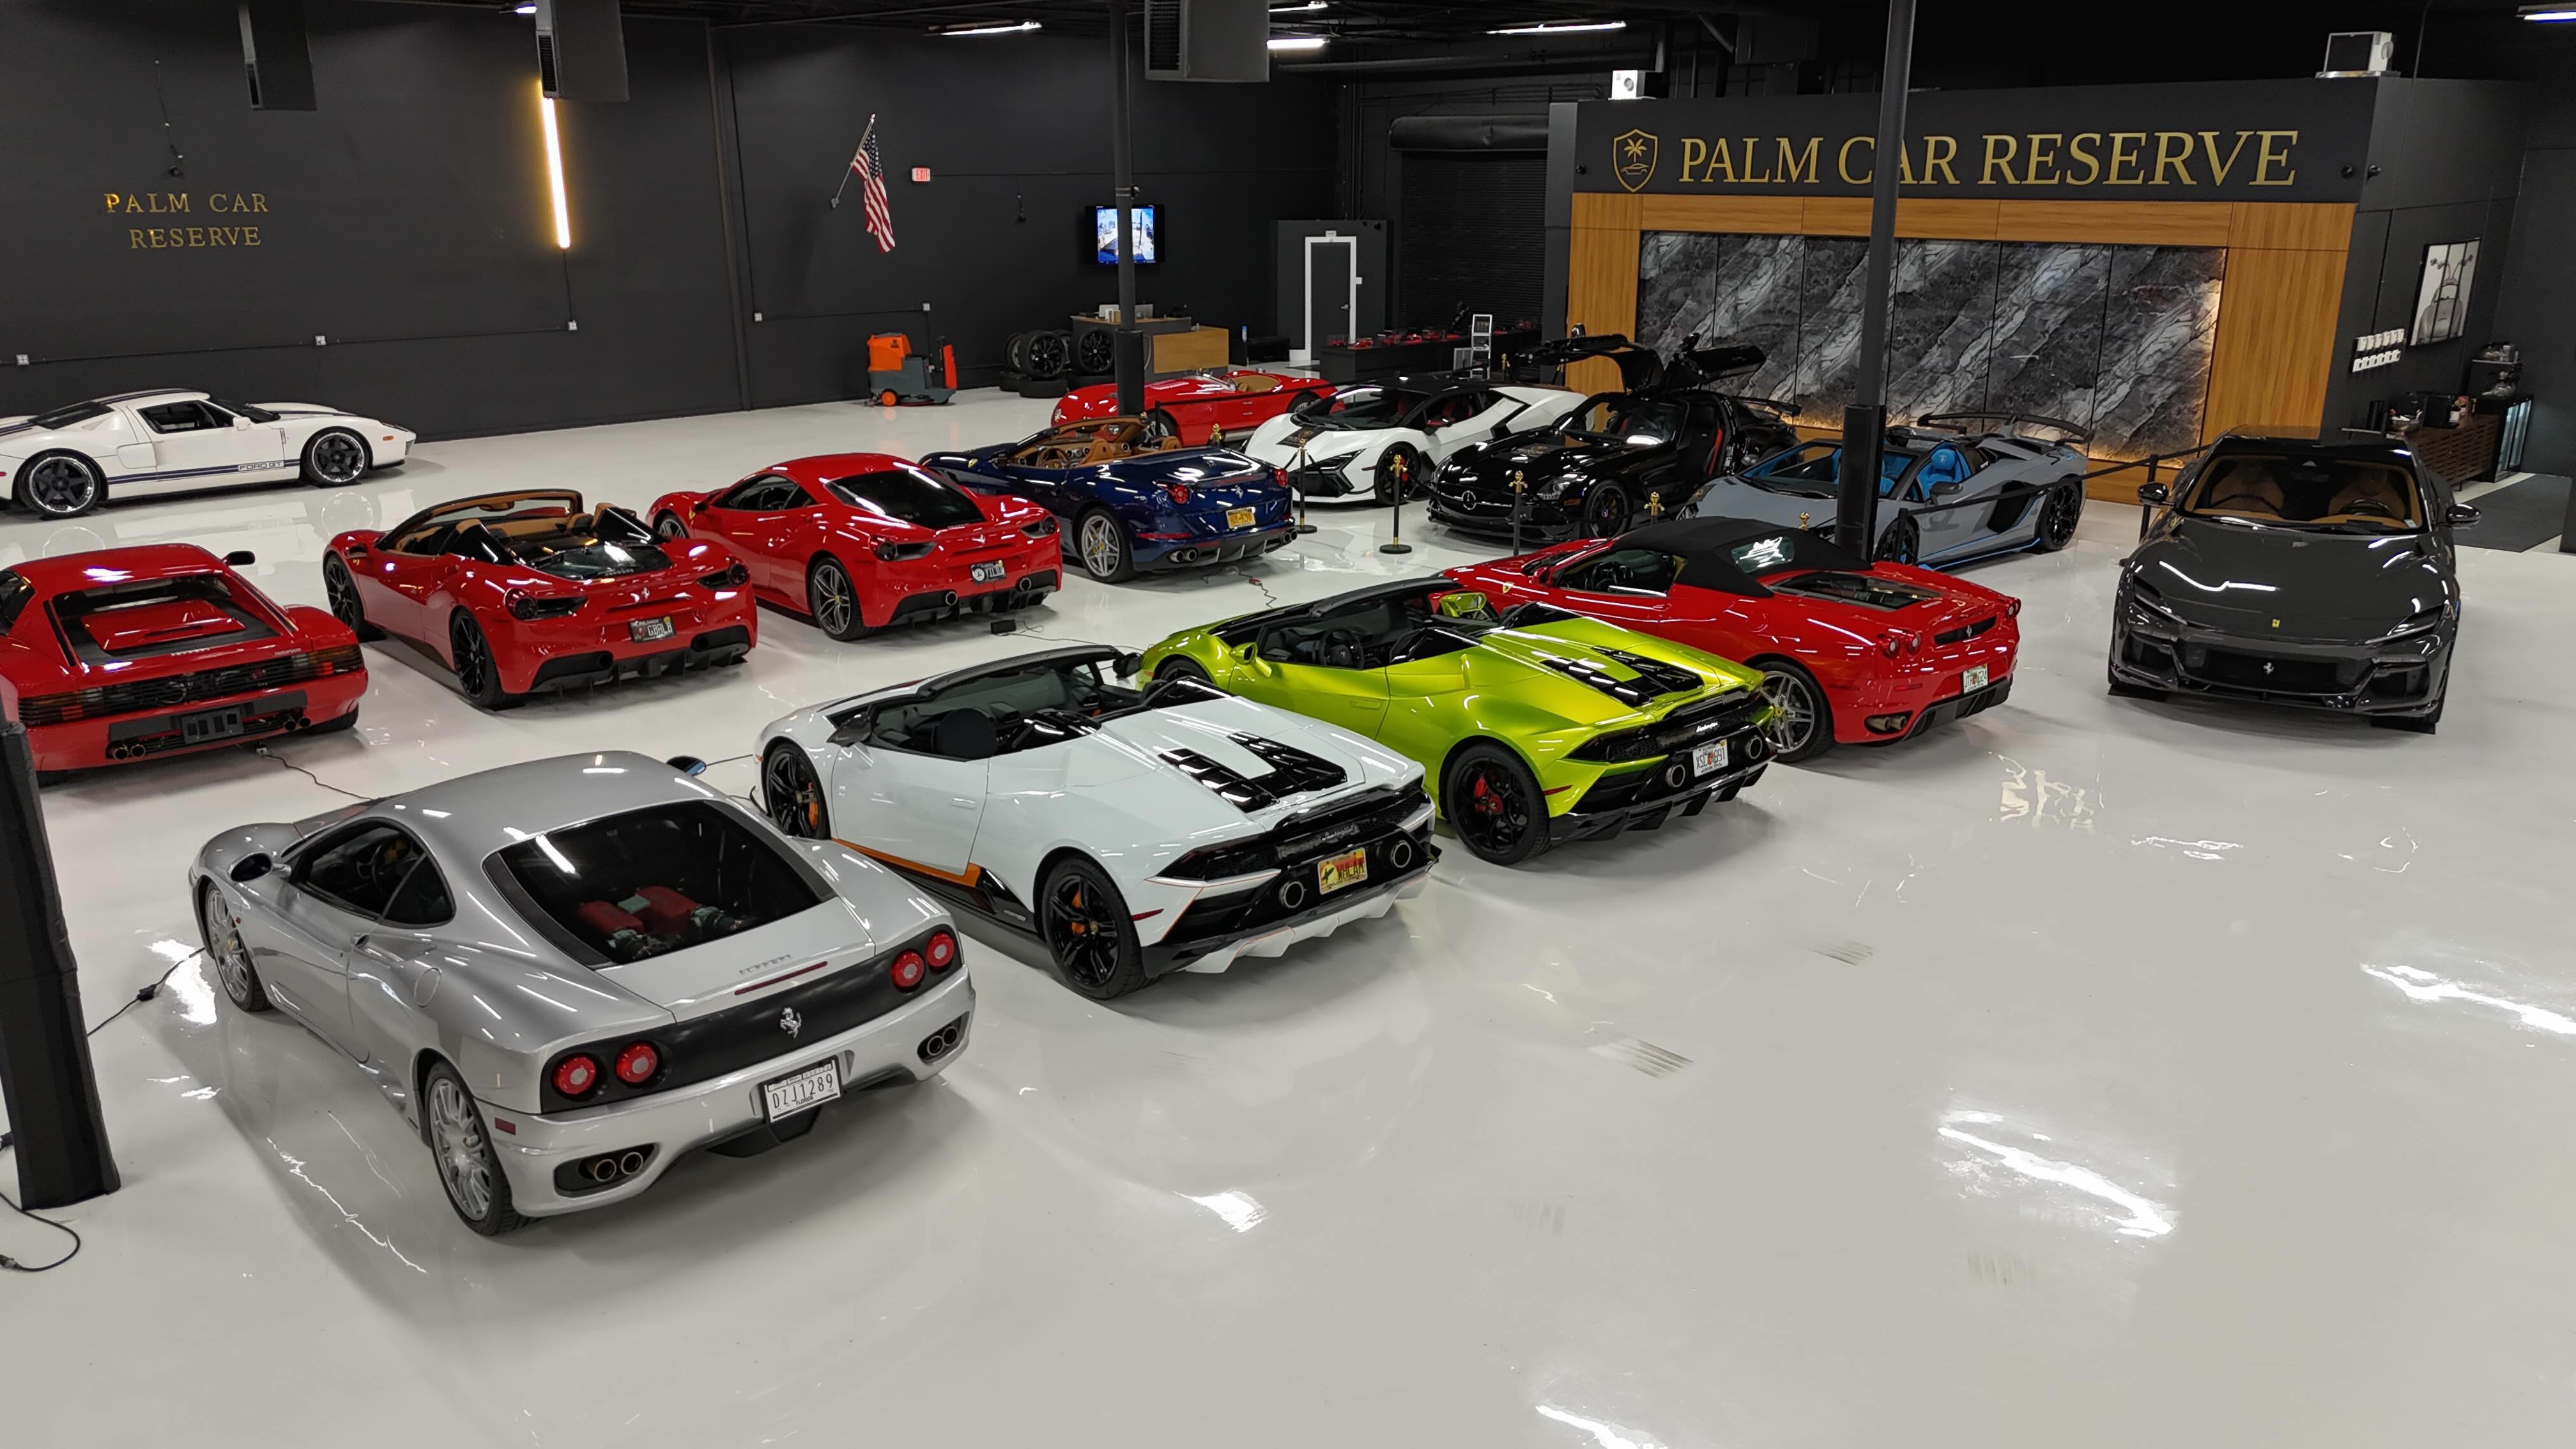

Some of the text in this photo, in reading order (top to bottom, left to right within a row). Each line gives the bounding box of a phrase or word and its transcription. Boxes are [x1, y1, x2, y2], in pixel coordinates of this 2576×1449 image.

[1678, 137, 1824, 184] PALM
[1977, 130, 2299, 187] RESERVE
[916, 168, 928, 180] EXIT
[103, 193, 269, 213] PALM CAR
[128, 226, 261, 249] RESERVE
[240, 462, 267, 470] FORD
[1695, 752, 1708, 770] XSC
[772, 1073, 834, 1109] DZJ1289
